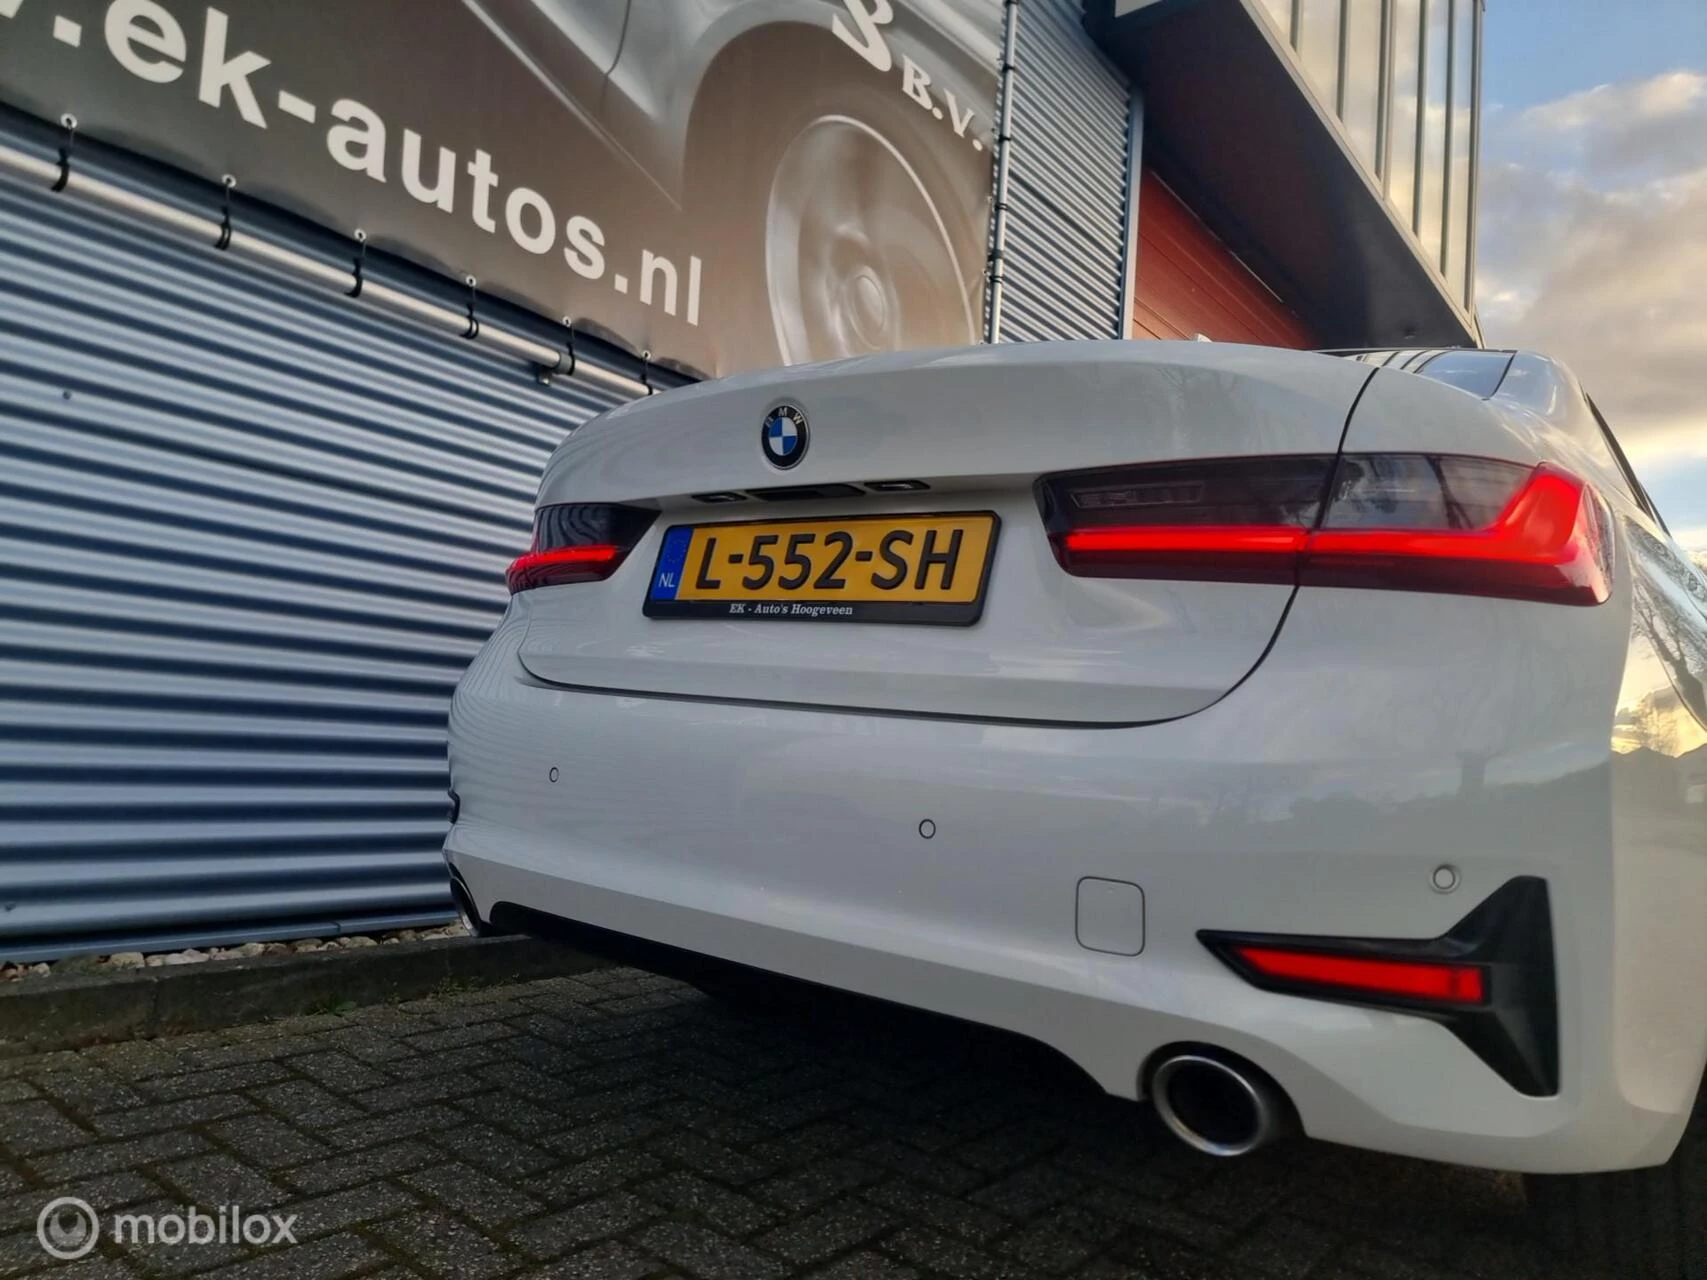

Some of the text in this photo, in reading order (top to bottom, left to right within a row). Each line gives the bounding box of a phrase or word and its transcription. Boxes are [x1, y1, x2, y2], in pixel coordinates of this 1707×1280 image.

[902, 53, 983, 152] B.V.
[0, 0, 702, 326] .ek-autos.nl
[765, 406, 803, 429] BMW
[658, 572, 675, 588] NL
[695, 529, 964, 590] L-552-SH
[729, 603, 746, 614] EK
[754, 603, 788, 614] Auto's
[791, 603, 853, 617] Hoogeveen
